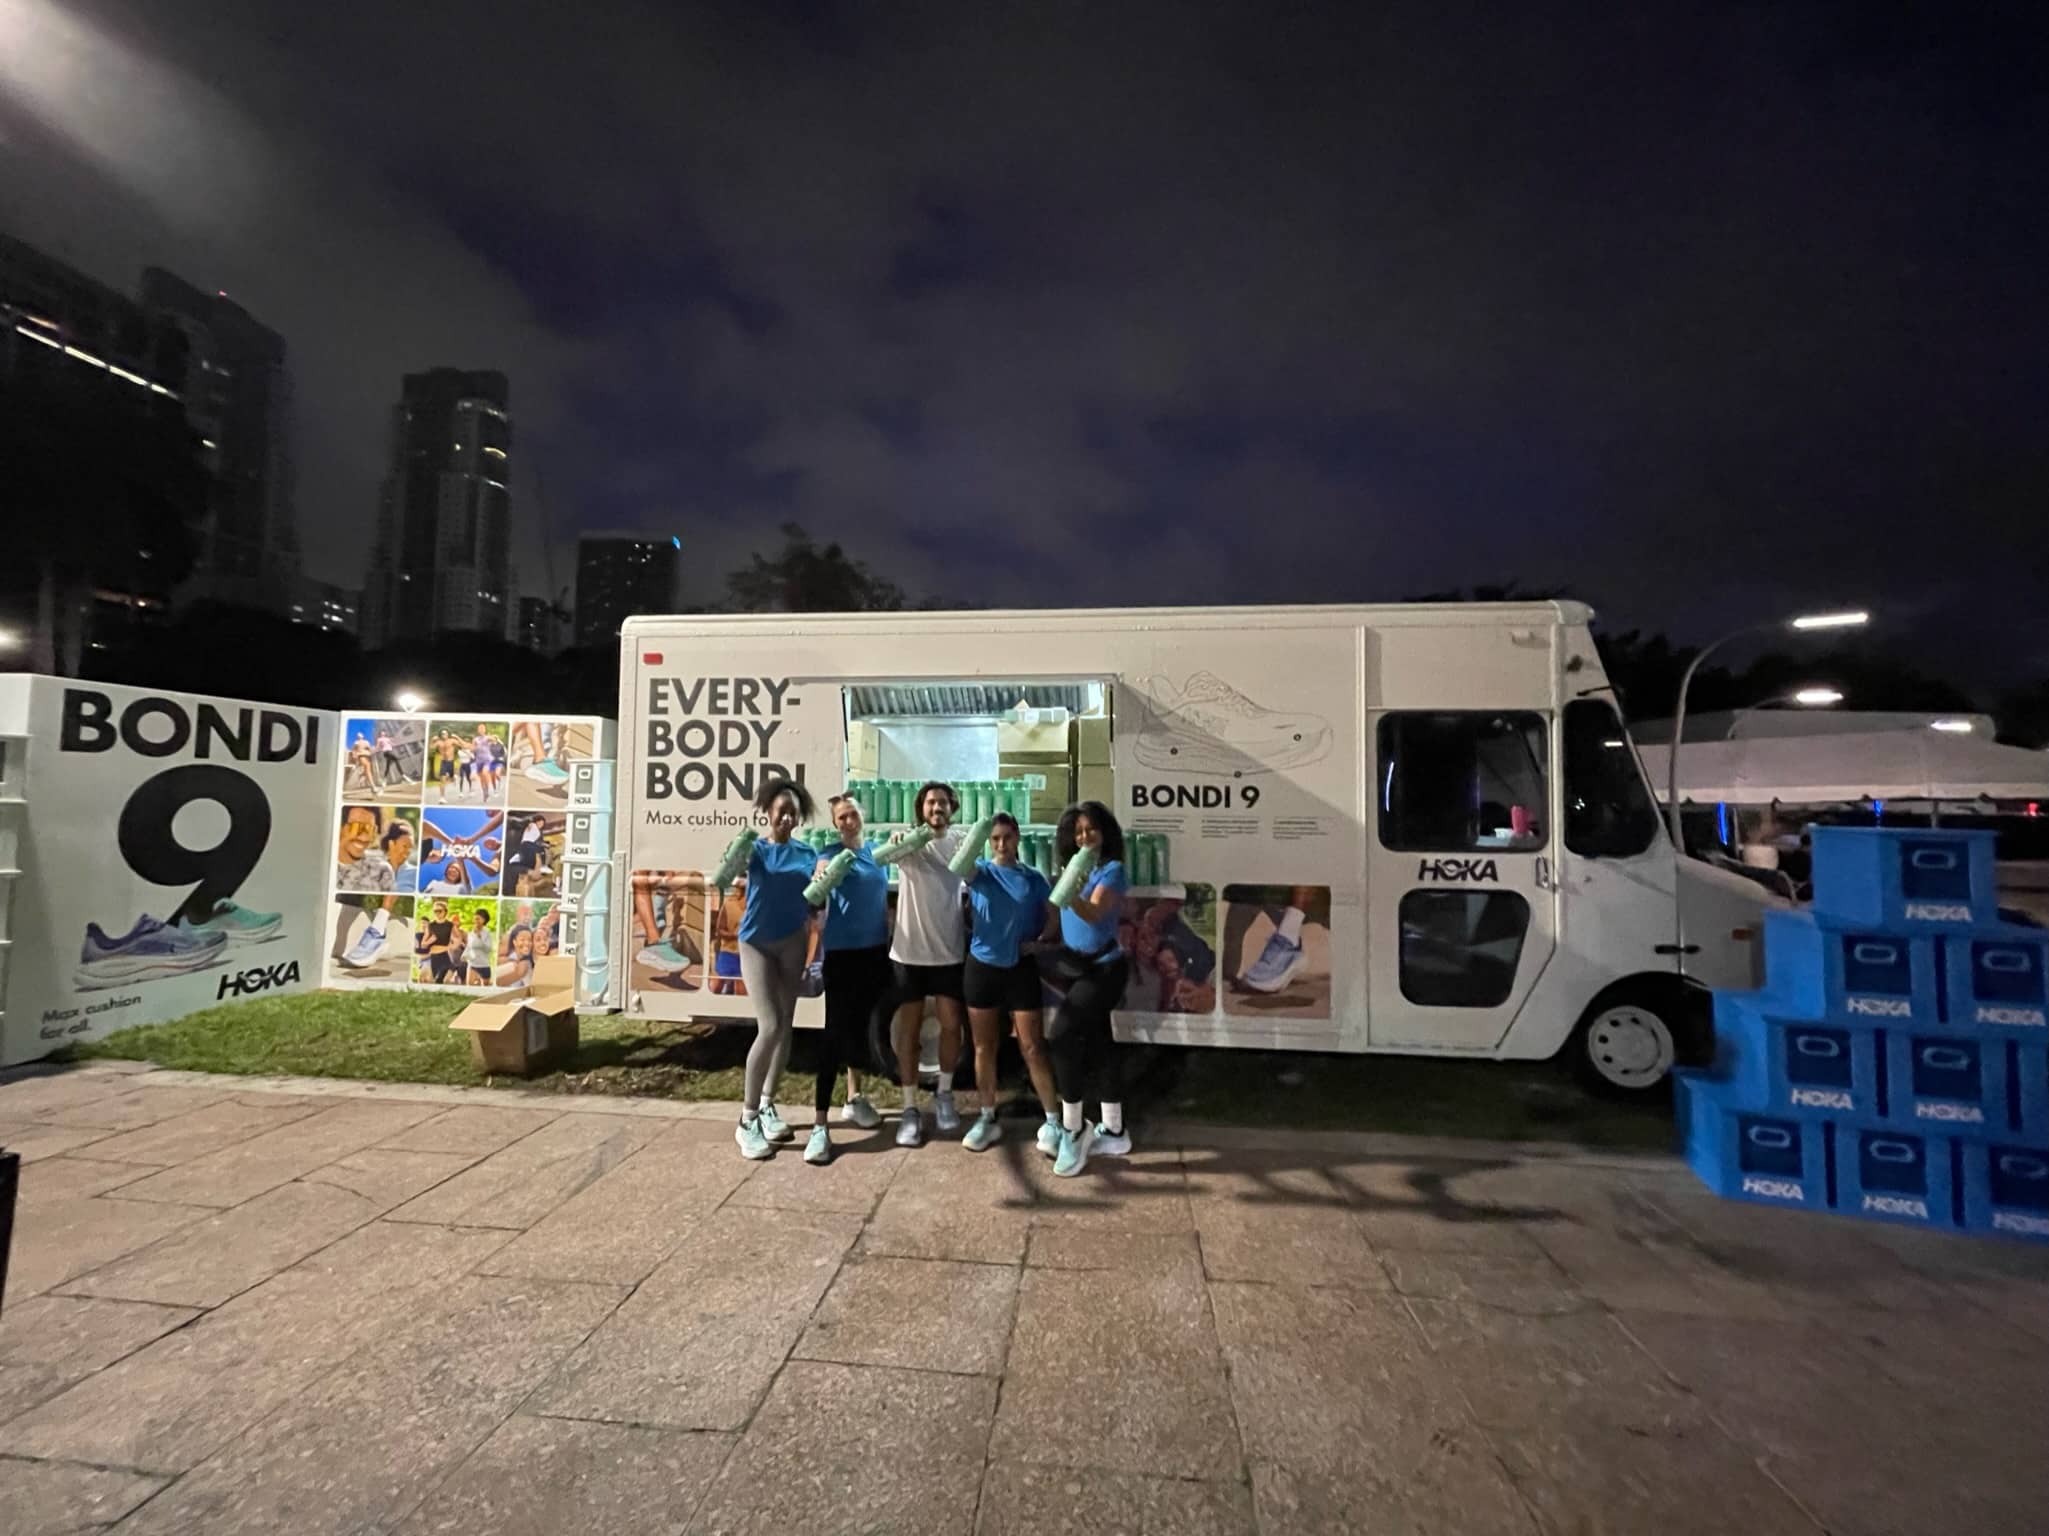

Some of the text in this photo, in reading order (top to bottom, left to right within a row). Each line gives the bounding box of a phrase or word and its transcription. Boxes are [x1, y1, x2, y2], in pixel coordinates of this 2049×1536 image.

[648, 677, 801, 715] EVERY-
[60, 688, 319, 765] BONDI
[647, 719, 783, 758] BODY
[1131, 785, 1260, 809] BONDI 9
[646, 810, 769, 826] Max cushion fo
[118, 764, 272, 926] 9
[440, 844, 481, 858] HOKA
[1418, 859, 1498, 882] HOKA
[1905, 904, 1972, 922] HOKA
[216, 960, 300, 1000] HOKA
[42, 996, 142, 1024] Max cushion
[1847, 998, 1911, 1017] HOKA
[1976, 1007, 2046, 1026] HOKA
[40, 1025, 65, 1040] for
[1791, 1089, 1854, 1110] HOKA
[1915, 1101, 1984, 1122] HOKA
[1743, 1178, 1804, 1200] HOKA
[1863, 1195, 1928, 1219] HOKA
